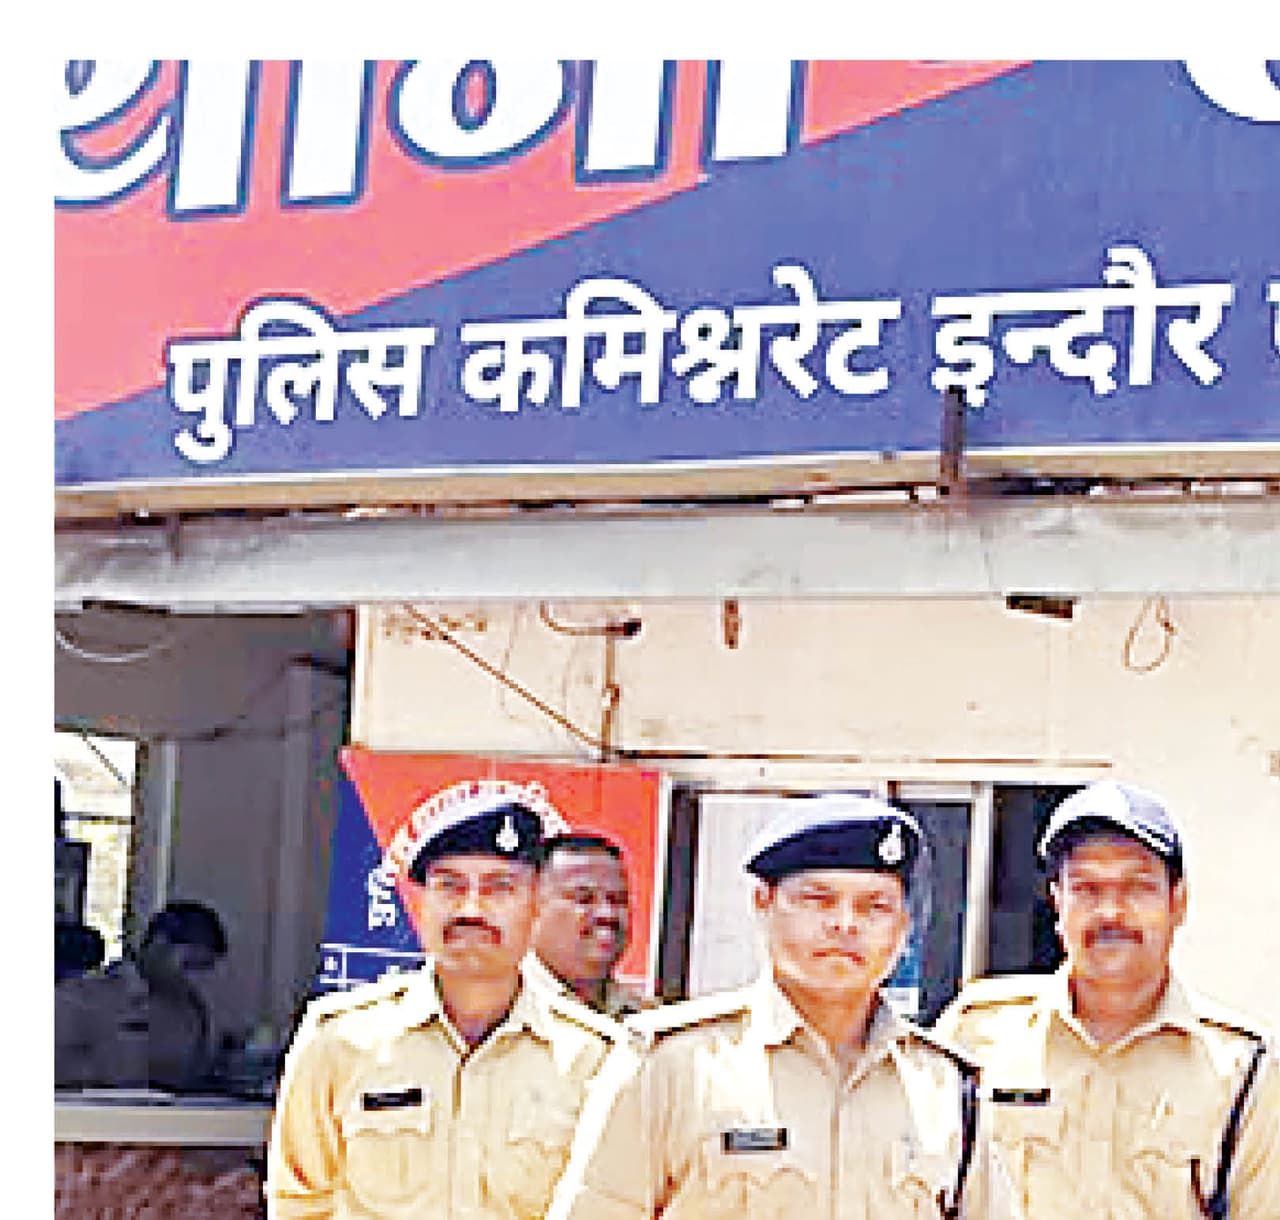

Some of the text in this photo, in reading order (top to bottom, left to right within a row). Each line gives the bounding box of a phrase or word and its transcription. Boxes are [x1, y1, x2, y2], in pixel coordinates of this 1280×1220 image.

[168, 294, 436, 461] पुलिस
[460, 264, 902, 412] कमिश्नरेट
[931, 244, 1236, 408] इन्दौर
